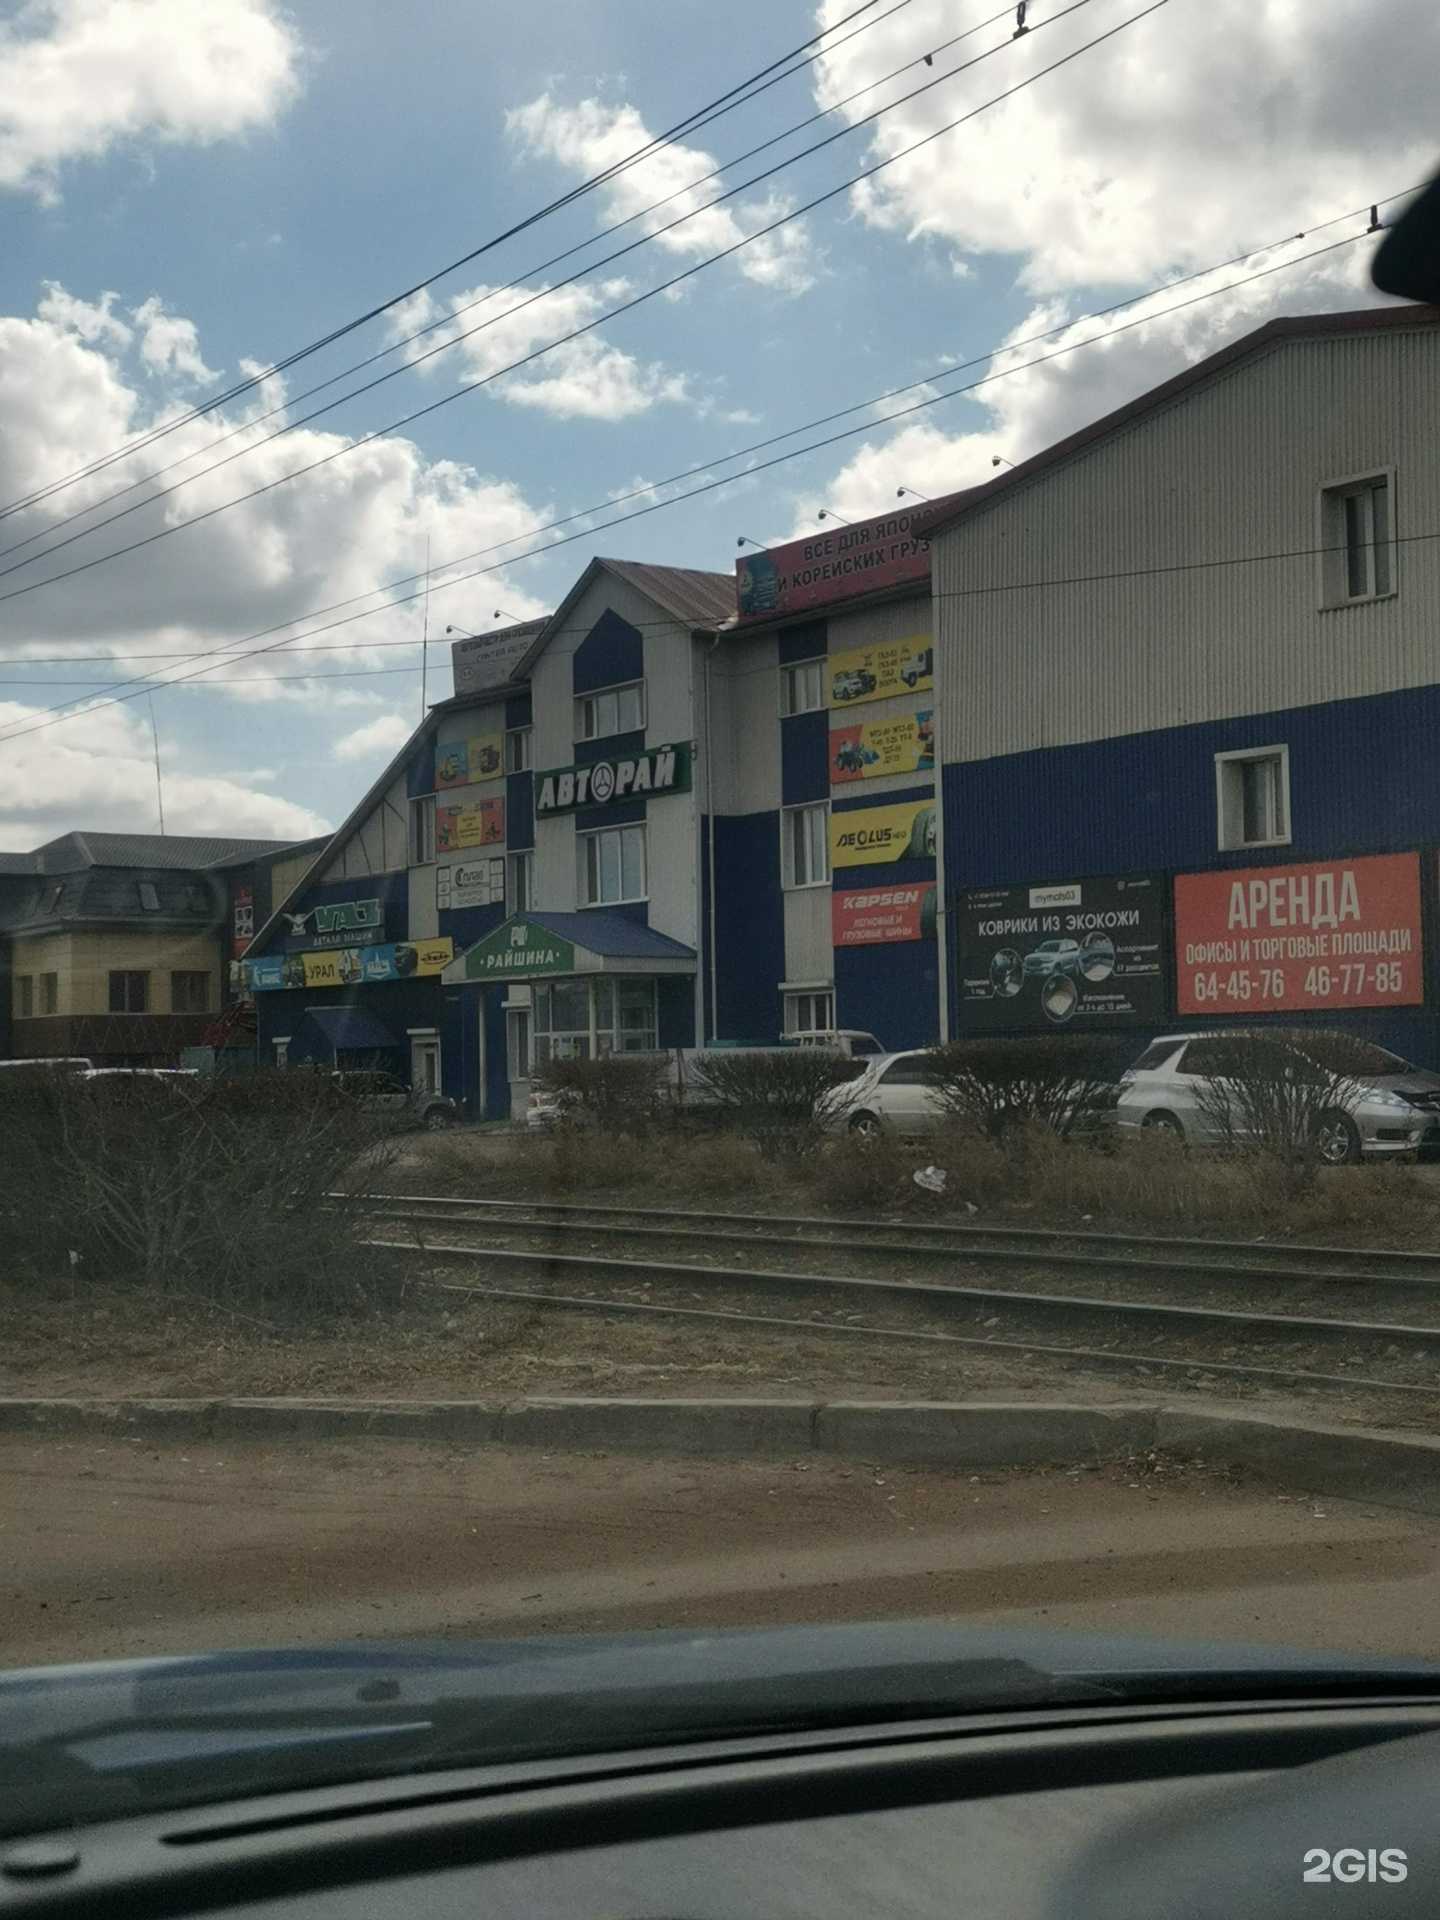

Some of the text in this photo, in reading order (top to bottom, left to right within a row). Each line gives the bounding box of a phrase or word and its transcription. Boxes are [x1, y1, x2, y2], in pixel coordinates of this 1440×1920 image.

[803, 541, 833, 561] ВСЕ
[838, 529, 870, 551] ДЛЯ
[778, 578, 787, 592] И
[836, 828, 893, 848] AEOLUS
[1228, 871, 1361, 930] АРЕНДА
[978, 909, 1140, 937] КОВРИКИ ИЗ ЭКОКОЖИ
[486, 949, 555, 969] РАЙШИНА
[1186, 942, 1237, 965] ОФИСЫ
[1240, 941, 1251, 962] И
[1252, 934, 1329, 962] ТОРГОВЫЕ
[1332, 928, 1412, 956] ПЛОЩАДИ
[309, 963, 336, 979] УРАЛ
[1194, 962, 1403, 1001] 64-45-76 46-77-85
